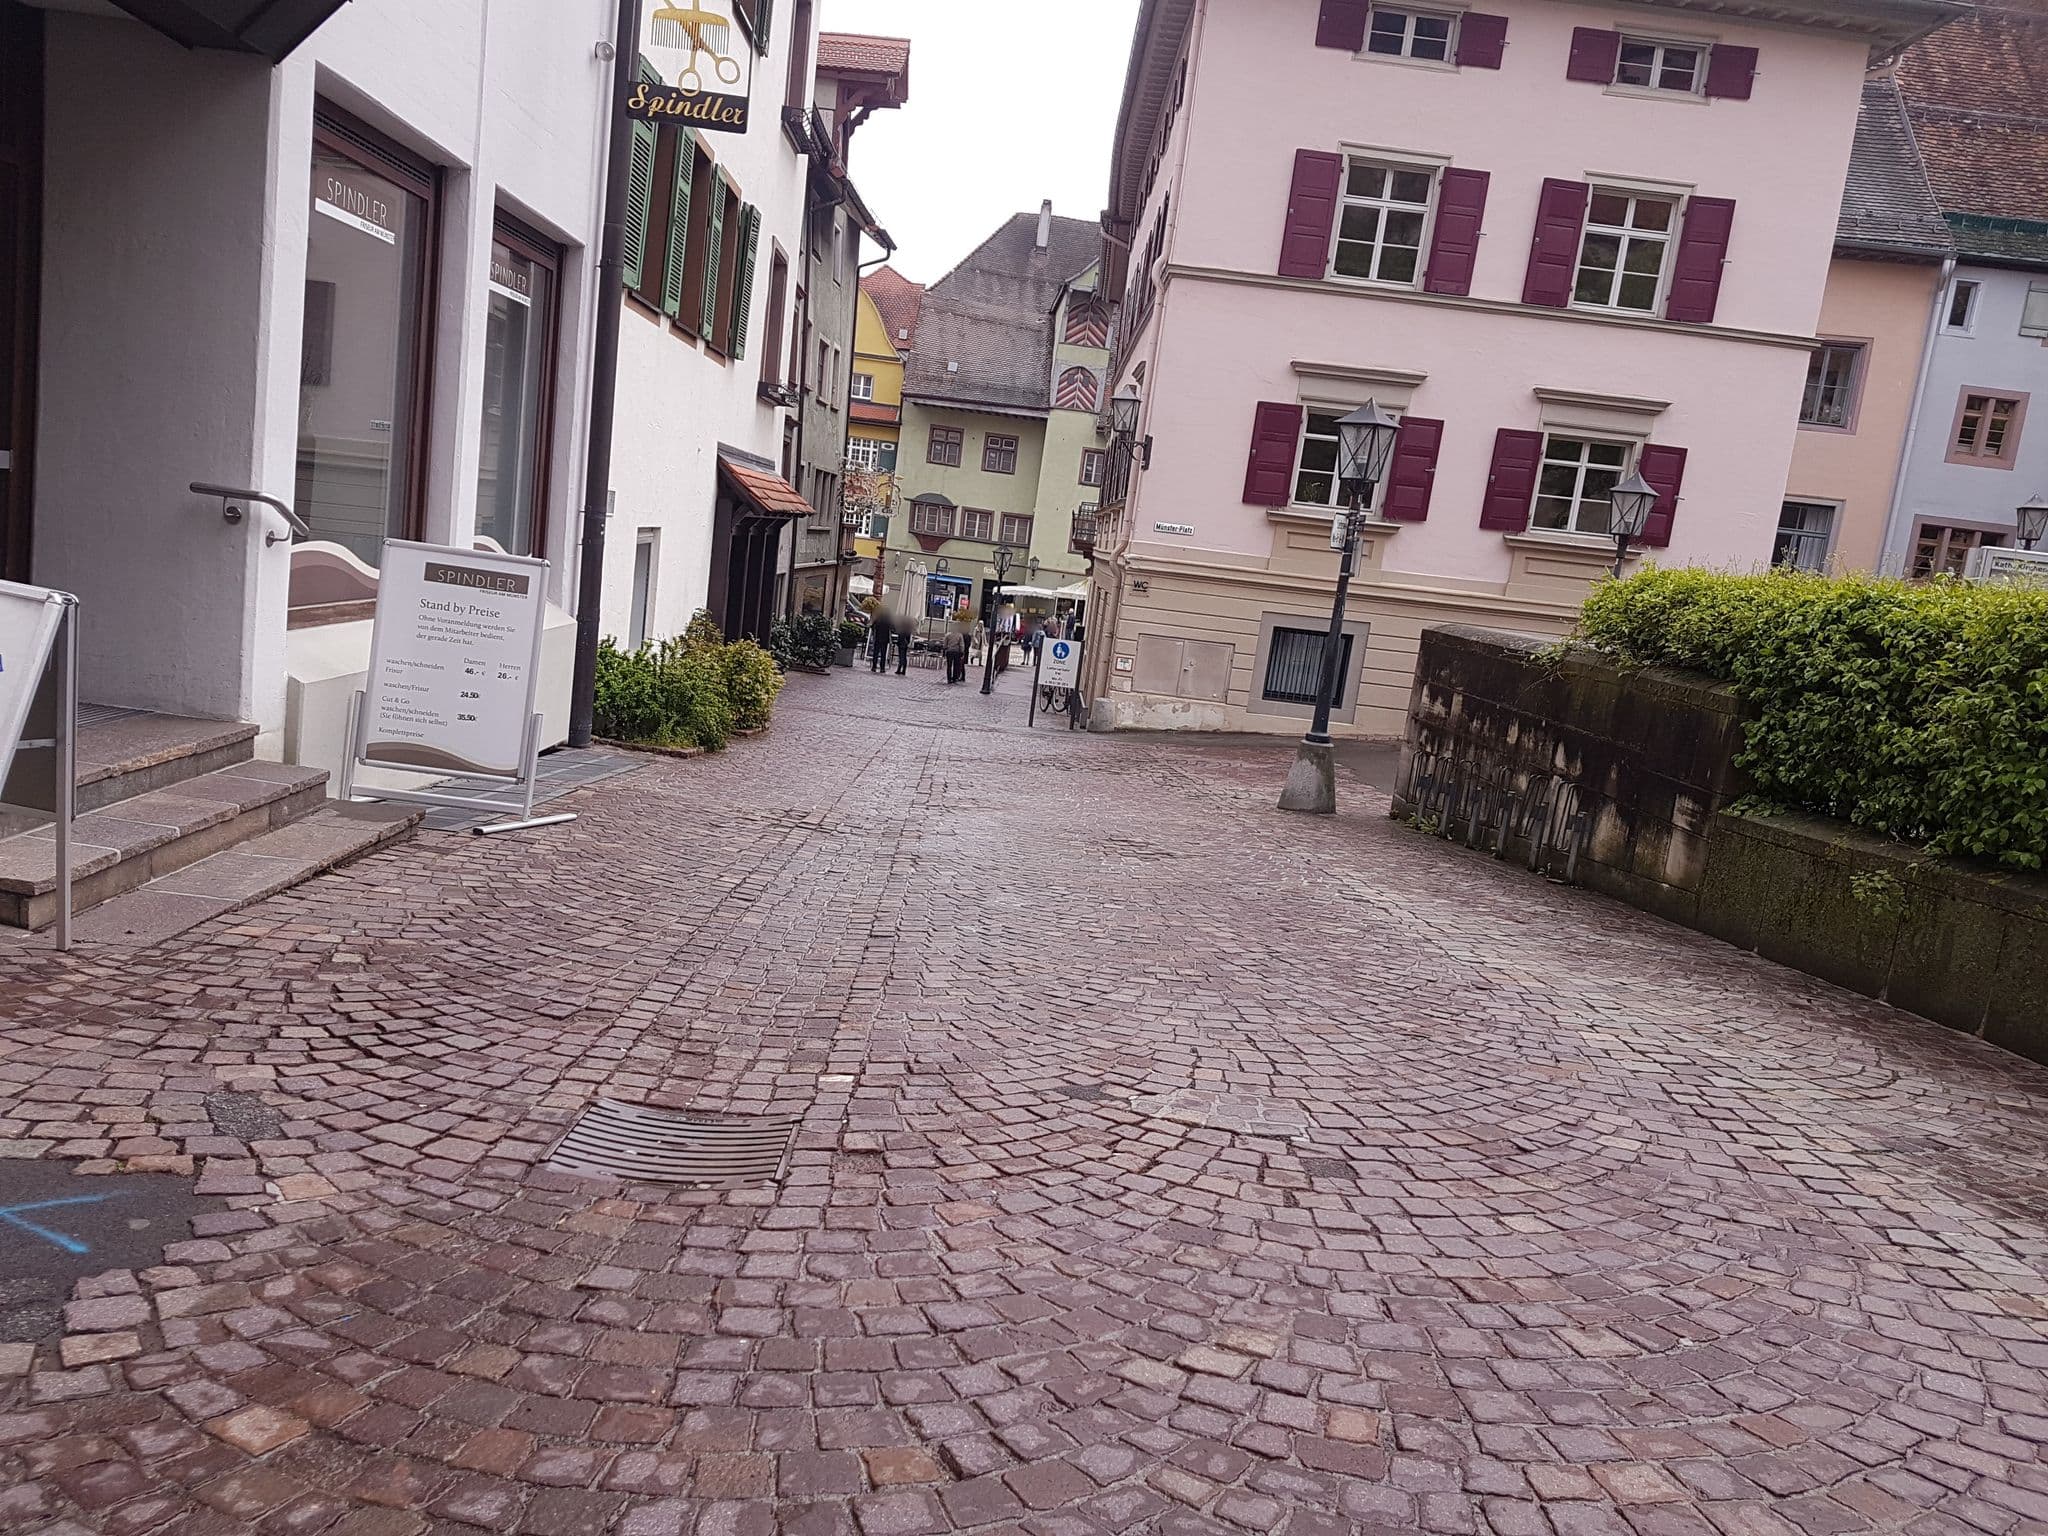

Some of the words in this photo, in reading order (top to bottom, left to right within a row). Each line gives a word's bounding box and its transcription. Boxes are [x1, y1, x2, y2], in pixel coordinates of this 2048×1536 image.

[628, 84, 745, 124] Spindler
[327, 177, 387, 228] SPINDLER
[490, 261, 527, 294] SPINDLER
[437, 569, 516, 592] SPINDLER
[1133, 580, 1149, 590] WC
[419, 598, 450, 612] Stand
[453, 602, 466, 616] by
[468, 605, 501, 619] Preise
[418, 614, 436, 623] Ohne
[437, 617, 481, 630] Voranmeldung
[482, 623, 505, 632] werden
[429, 625, 444, 633] dem
[445, 627, 479, 638] Mitarbeiter
